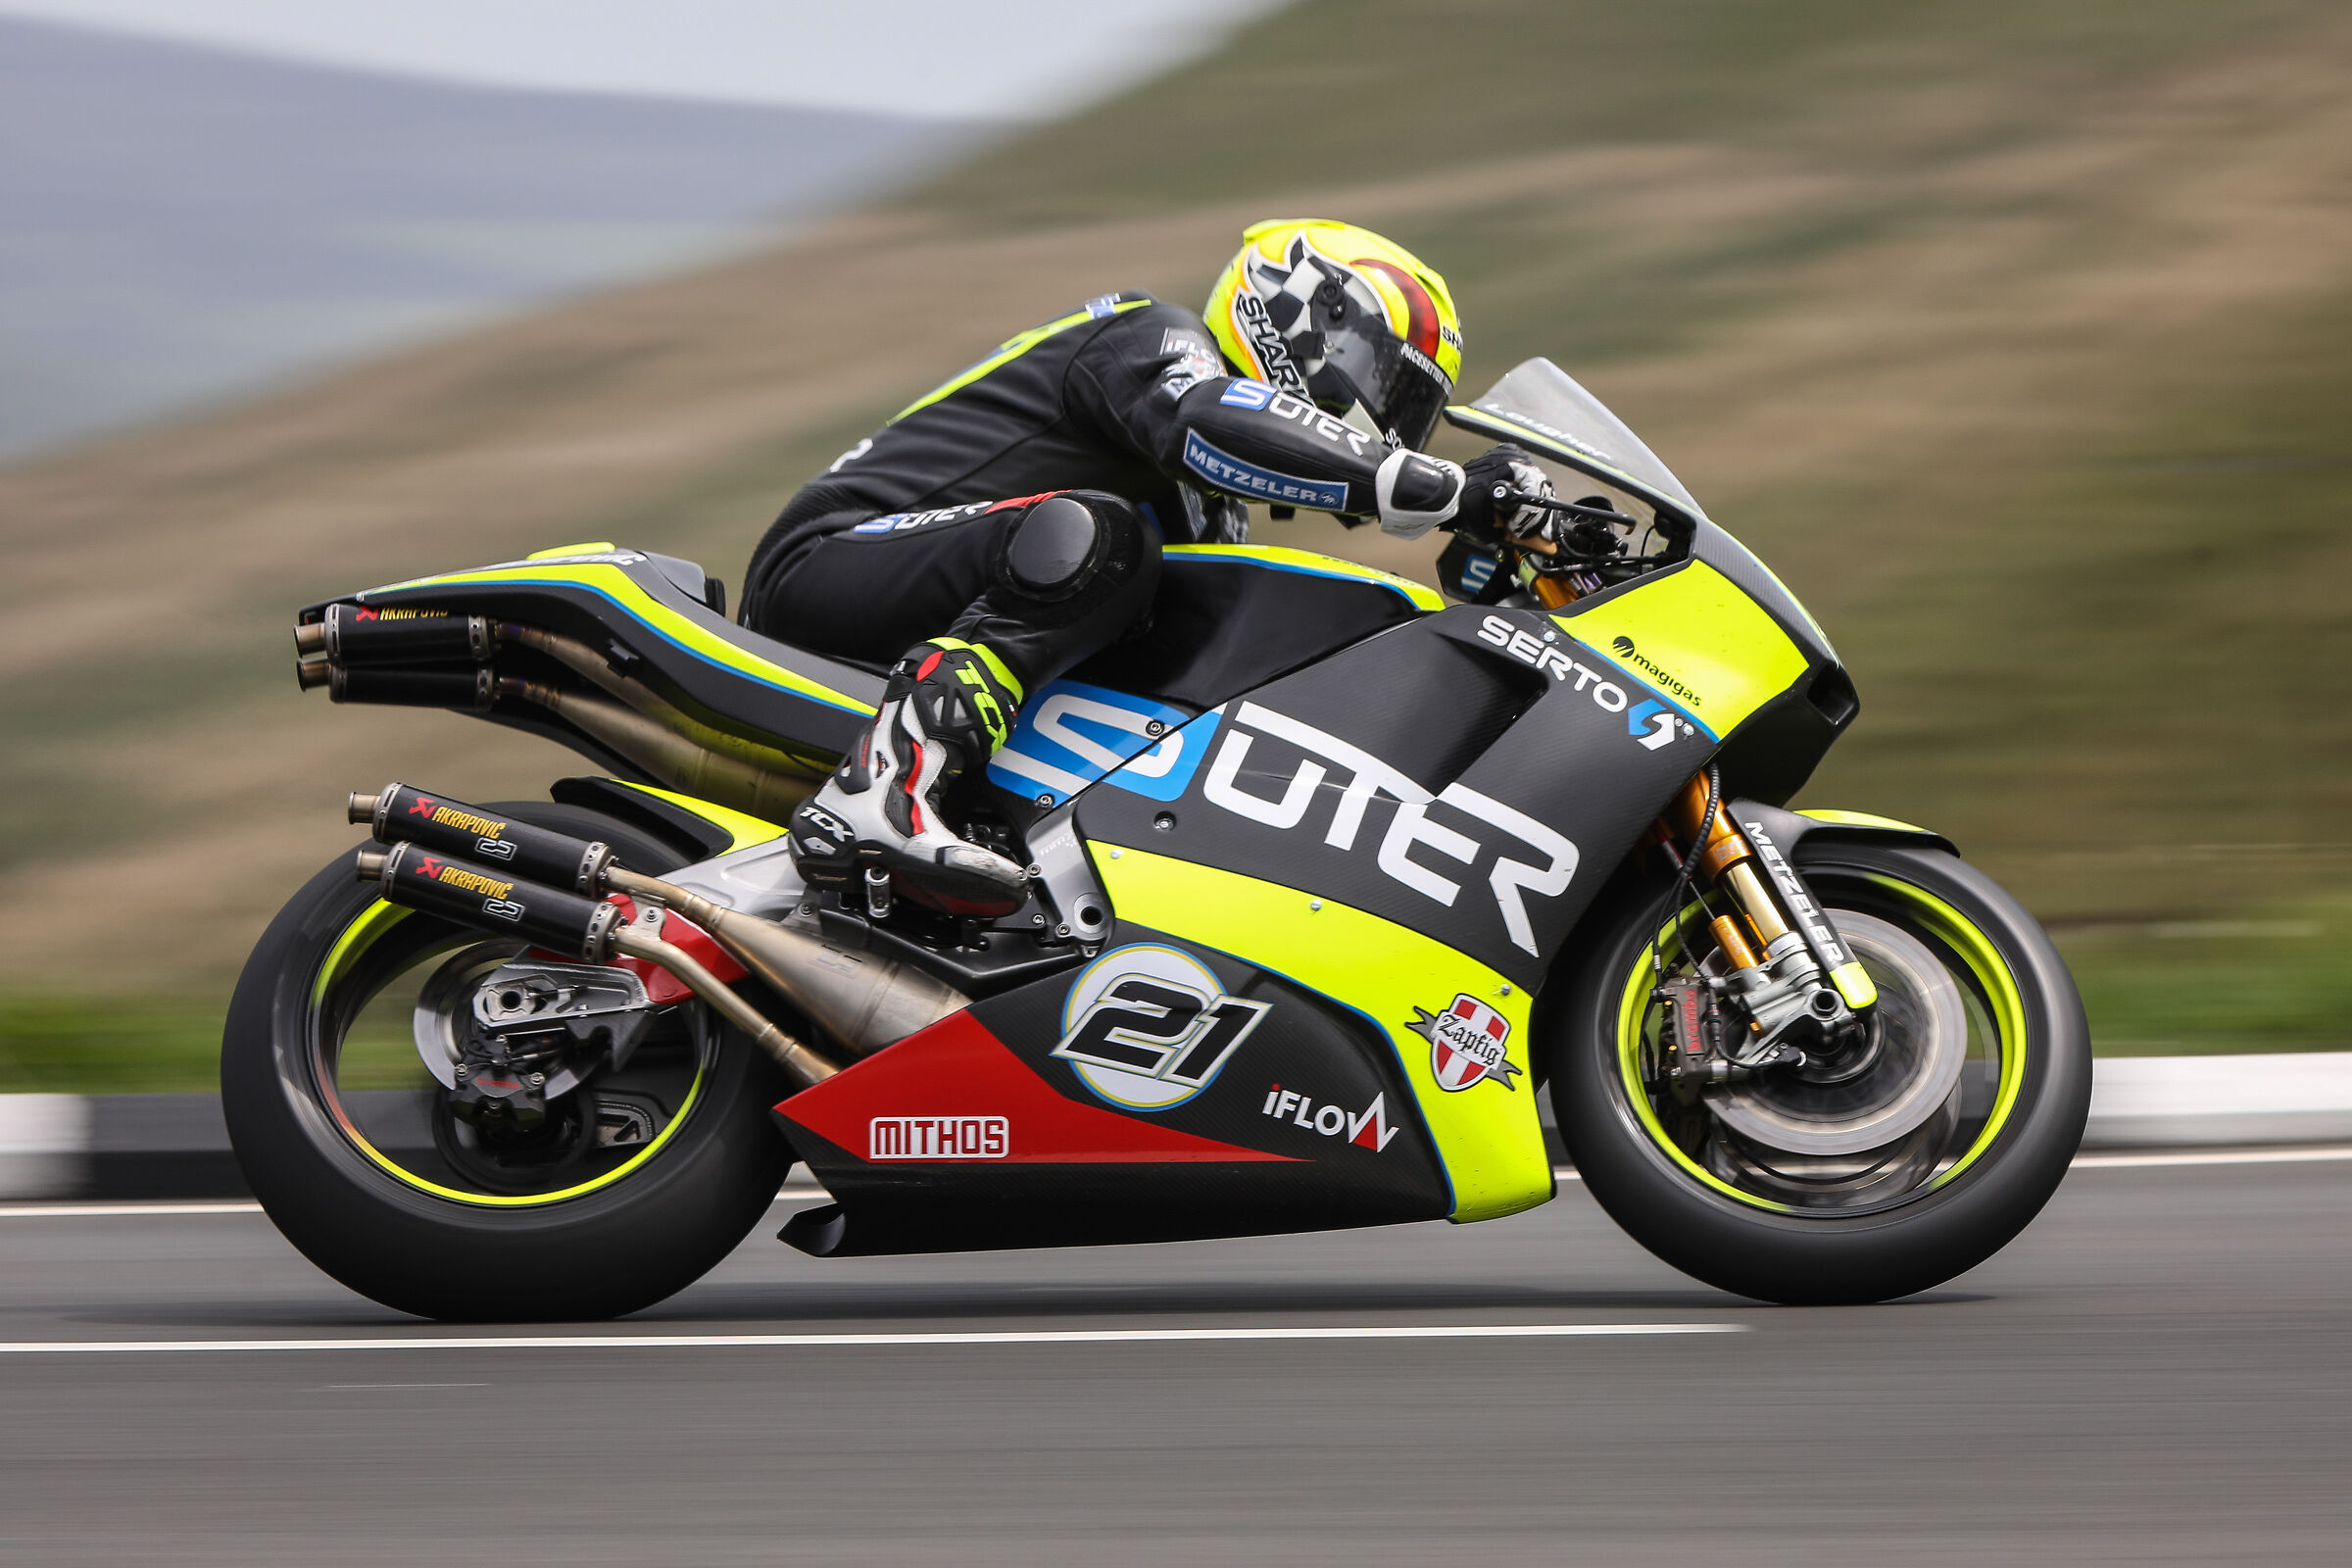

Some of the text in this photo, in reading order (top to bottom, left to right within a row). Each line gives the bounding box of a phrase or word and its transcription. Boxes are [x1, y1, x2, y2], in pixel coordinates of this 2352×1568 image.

[1189, 444, 1318, 502] METZELER
[1477, 614, 1628, 713] SERTO
[1634, 652, 1702, 708] magigas
[955, 661, 1007, 757] TCX
[800, 806, 855, 843] TCX
[988, 693, 1581, 958] SUTER
[1744, 821, 1845, 963] METZELER
[1053, 974, 1270, 1087] 21
[1681, 989, 1702, 1051] brembo
[872, 1119, 1006, 1157] MITHOS
